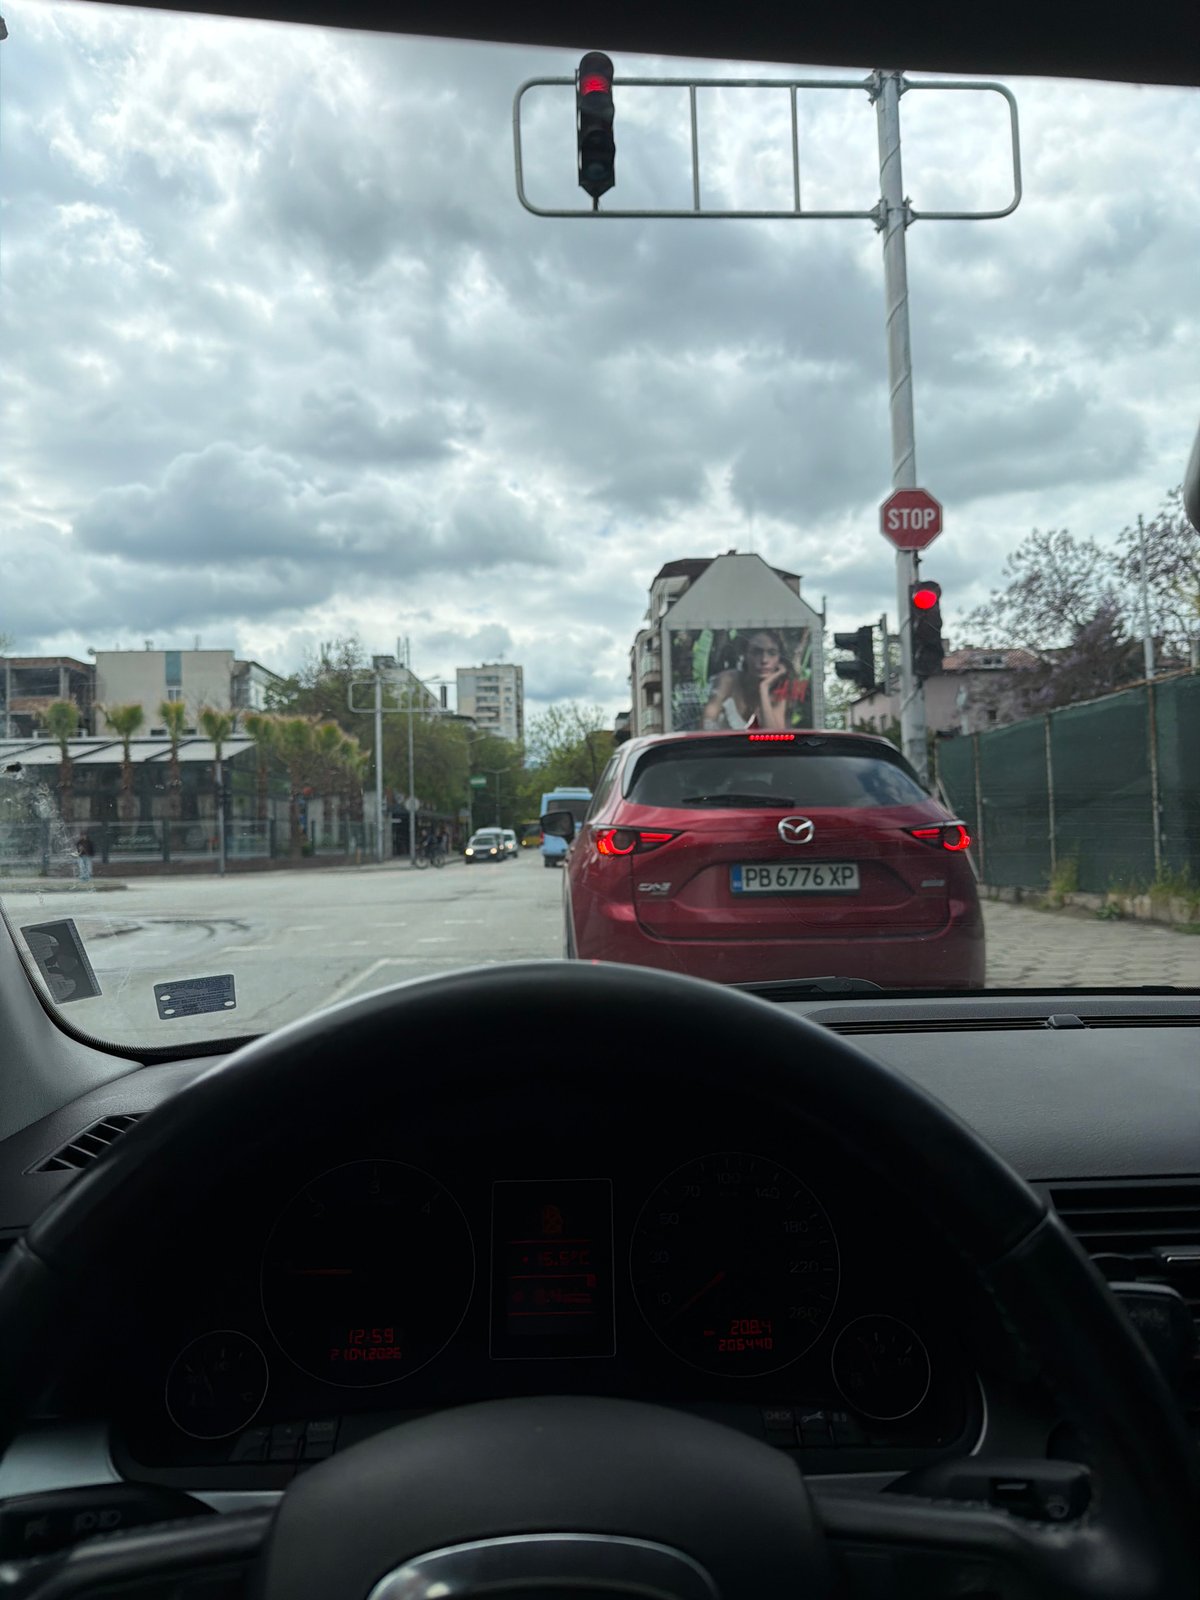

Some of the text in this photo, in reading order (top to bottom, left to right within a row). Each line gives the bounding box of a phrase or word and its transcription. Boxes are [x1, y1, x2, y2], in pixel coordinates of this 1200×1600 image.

[888, 508, 936, 530] STOP
[745, 868, 773, 888] PB
[776, 867, 824, 887] 6776
[829, 866, 855, 886] XP
[347, 1328, 395, 1345] 12:59
